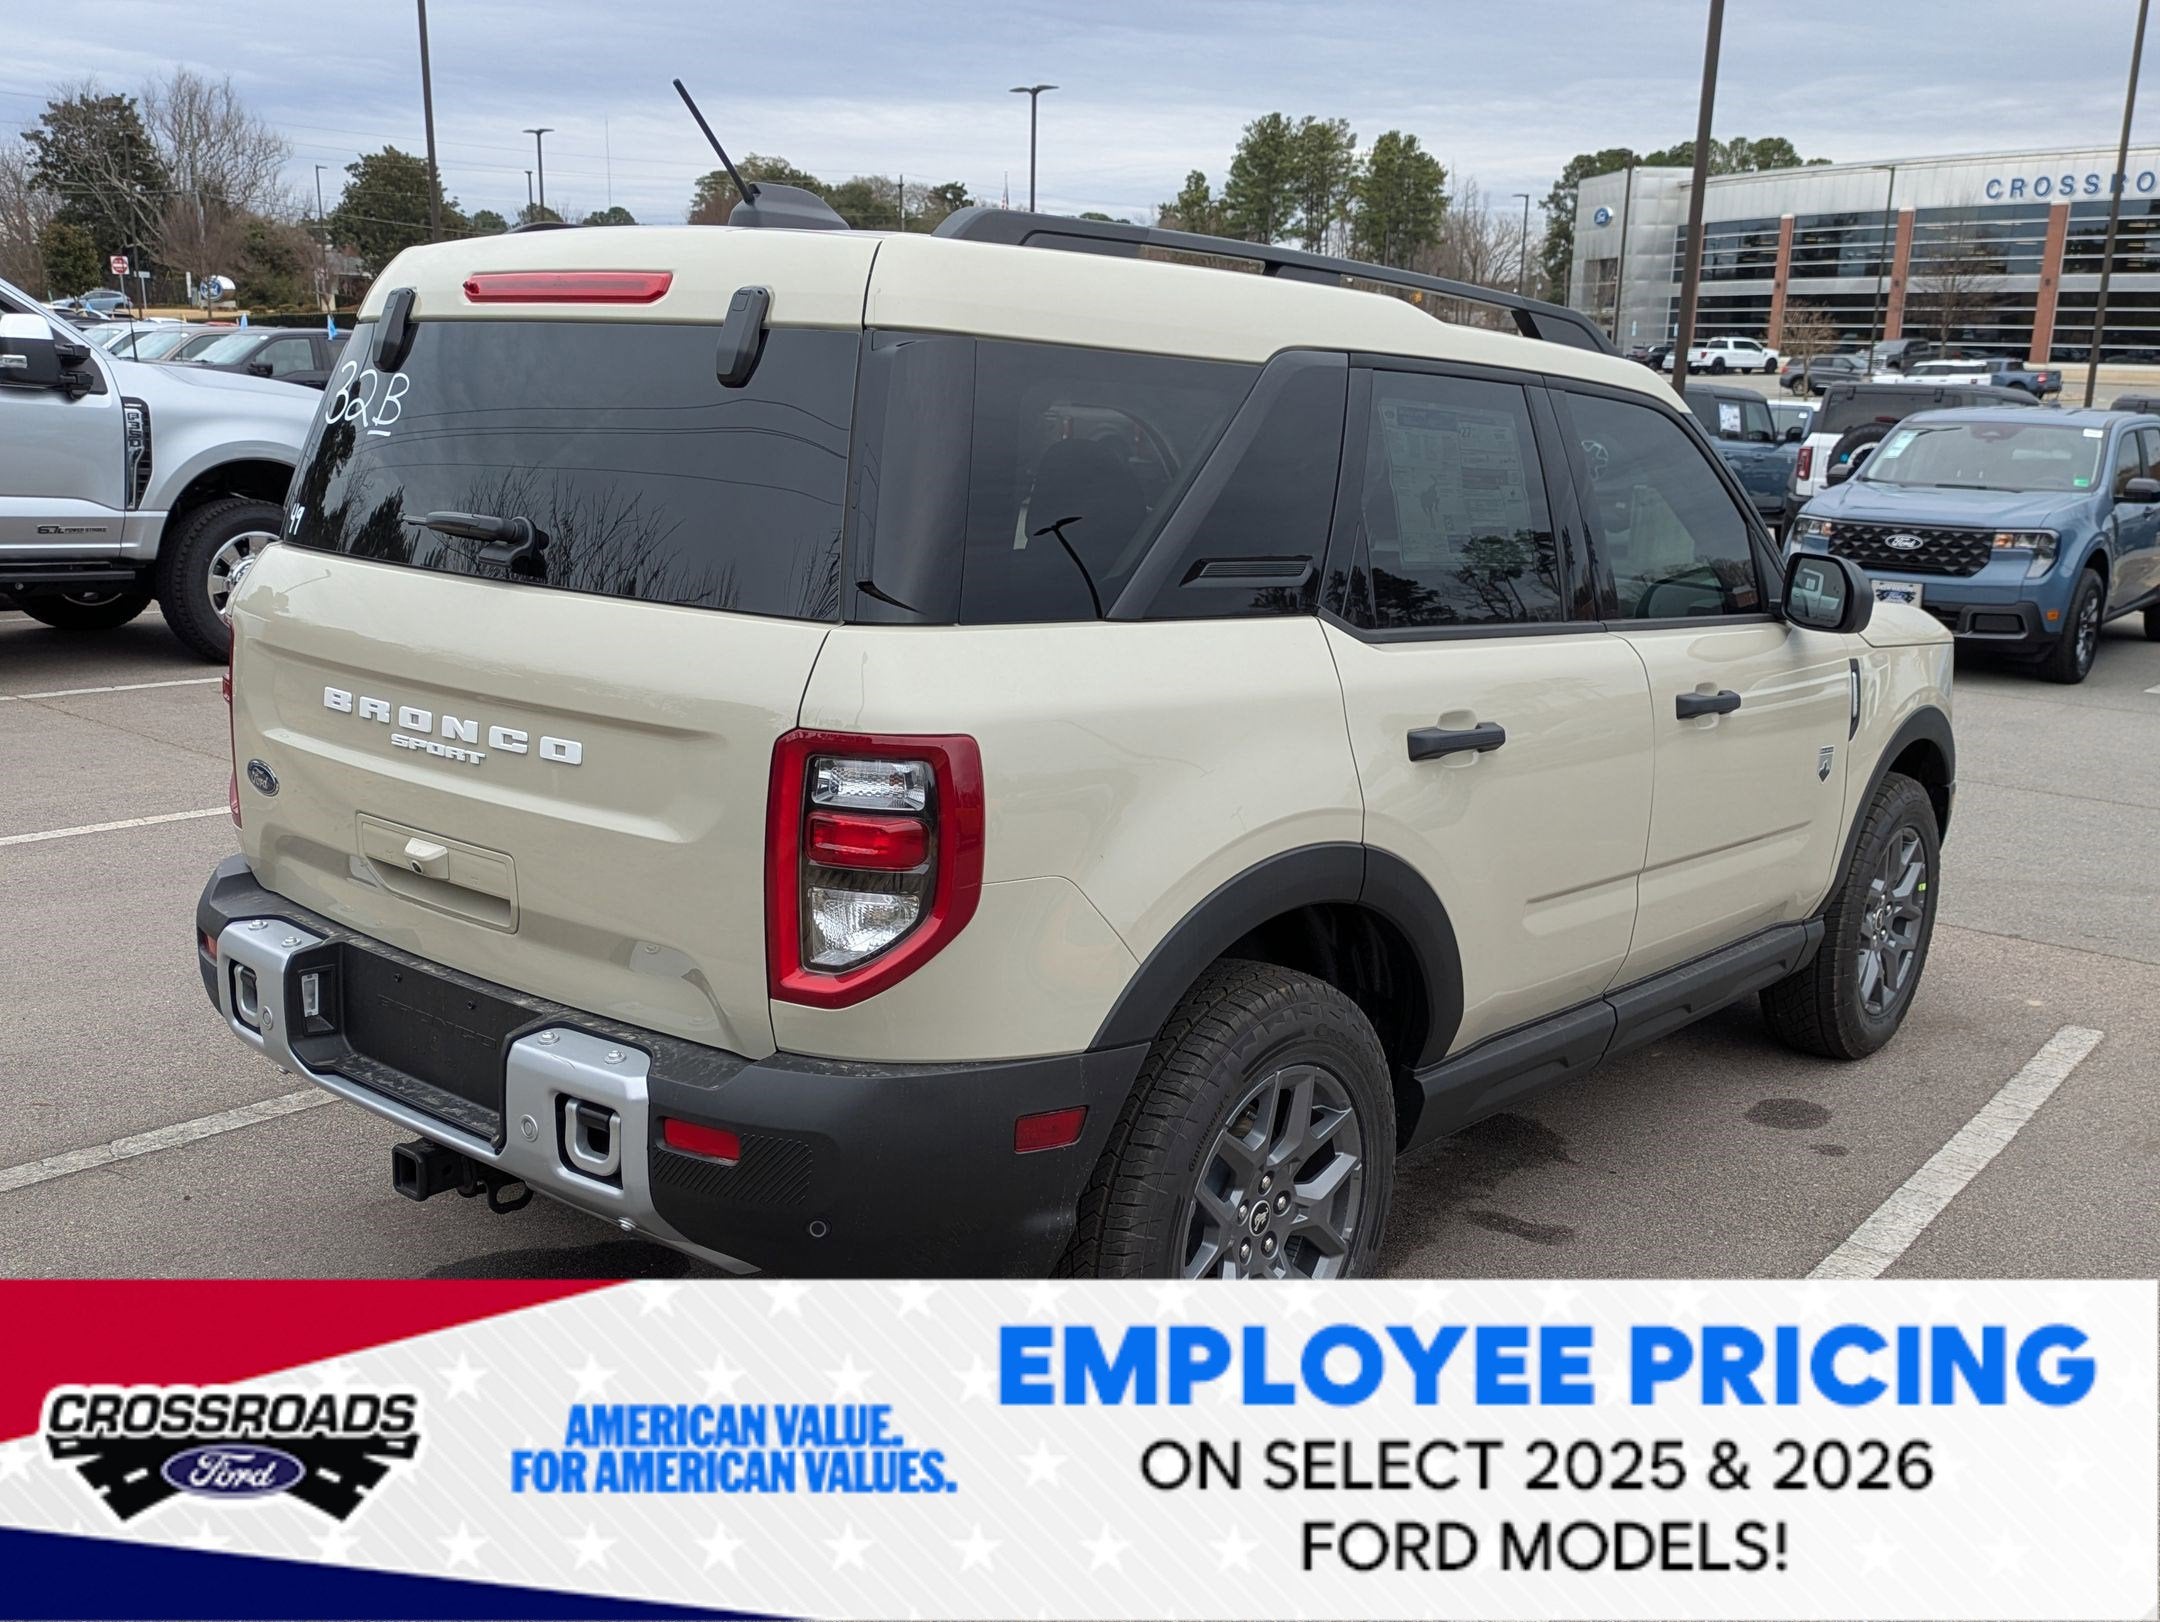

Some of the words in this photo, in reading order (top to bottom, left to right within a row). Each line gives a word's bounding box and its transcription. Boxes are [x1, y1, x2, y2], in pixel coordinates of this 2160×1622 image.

[325, 360, 410, 428] 32B
[288, 502, 305, 535] 49
[323, 686, 582, 766] BRONCO
[391, 733, 486, 765] SPORT
